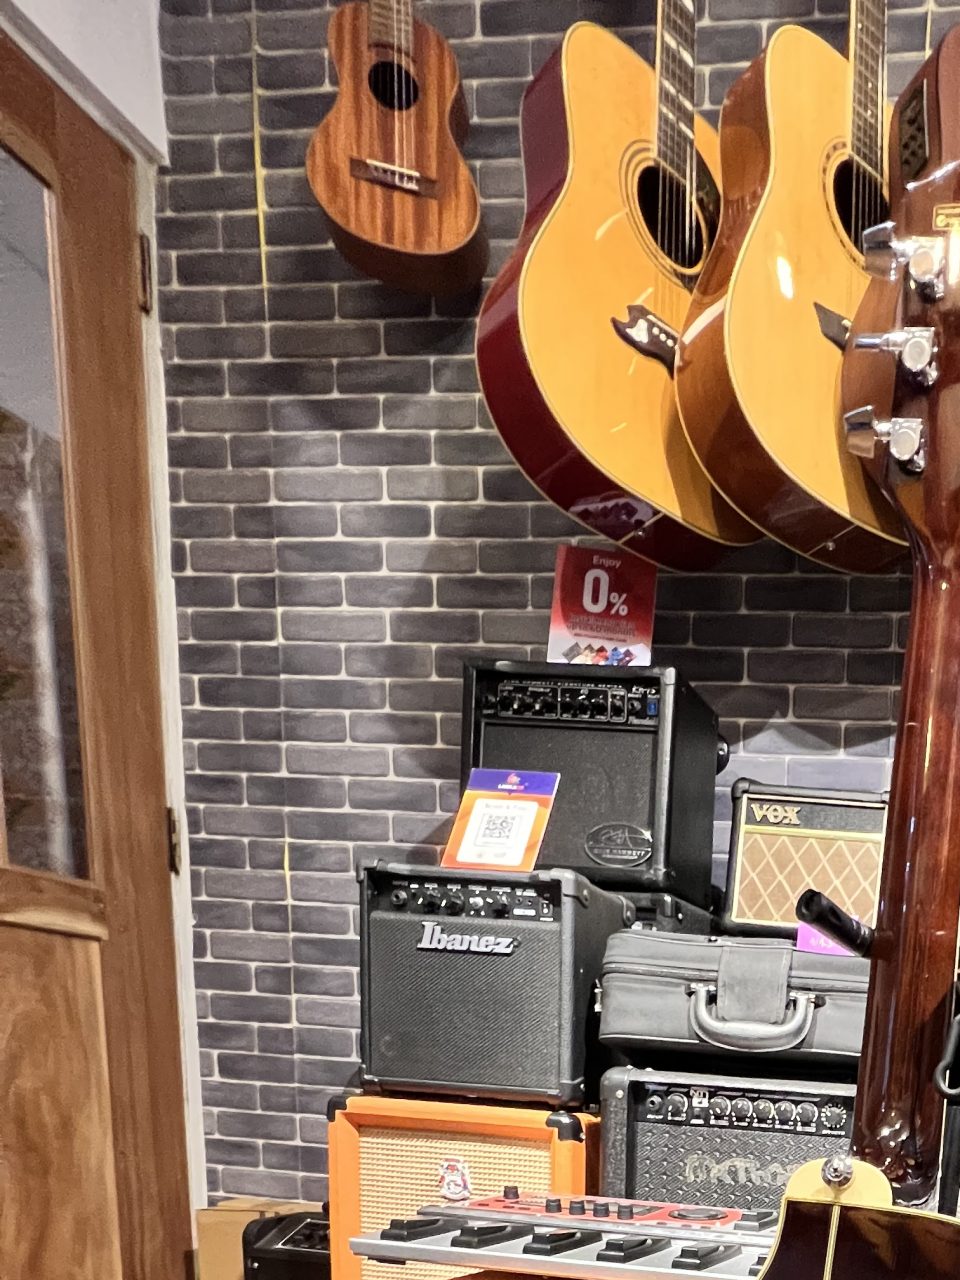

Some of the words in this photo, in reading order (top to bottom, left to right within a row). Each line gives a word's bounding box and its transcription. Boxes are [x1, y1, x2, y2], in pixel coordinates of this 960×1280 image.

[592, 555, 622, 569] Enjoy
[582, 568, 629, 617] 0%
[750, 803, 801, 825] VOX
[416, 921, 514, 954] Ibanez
